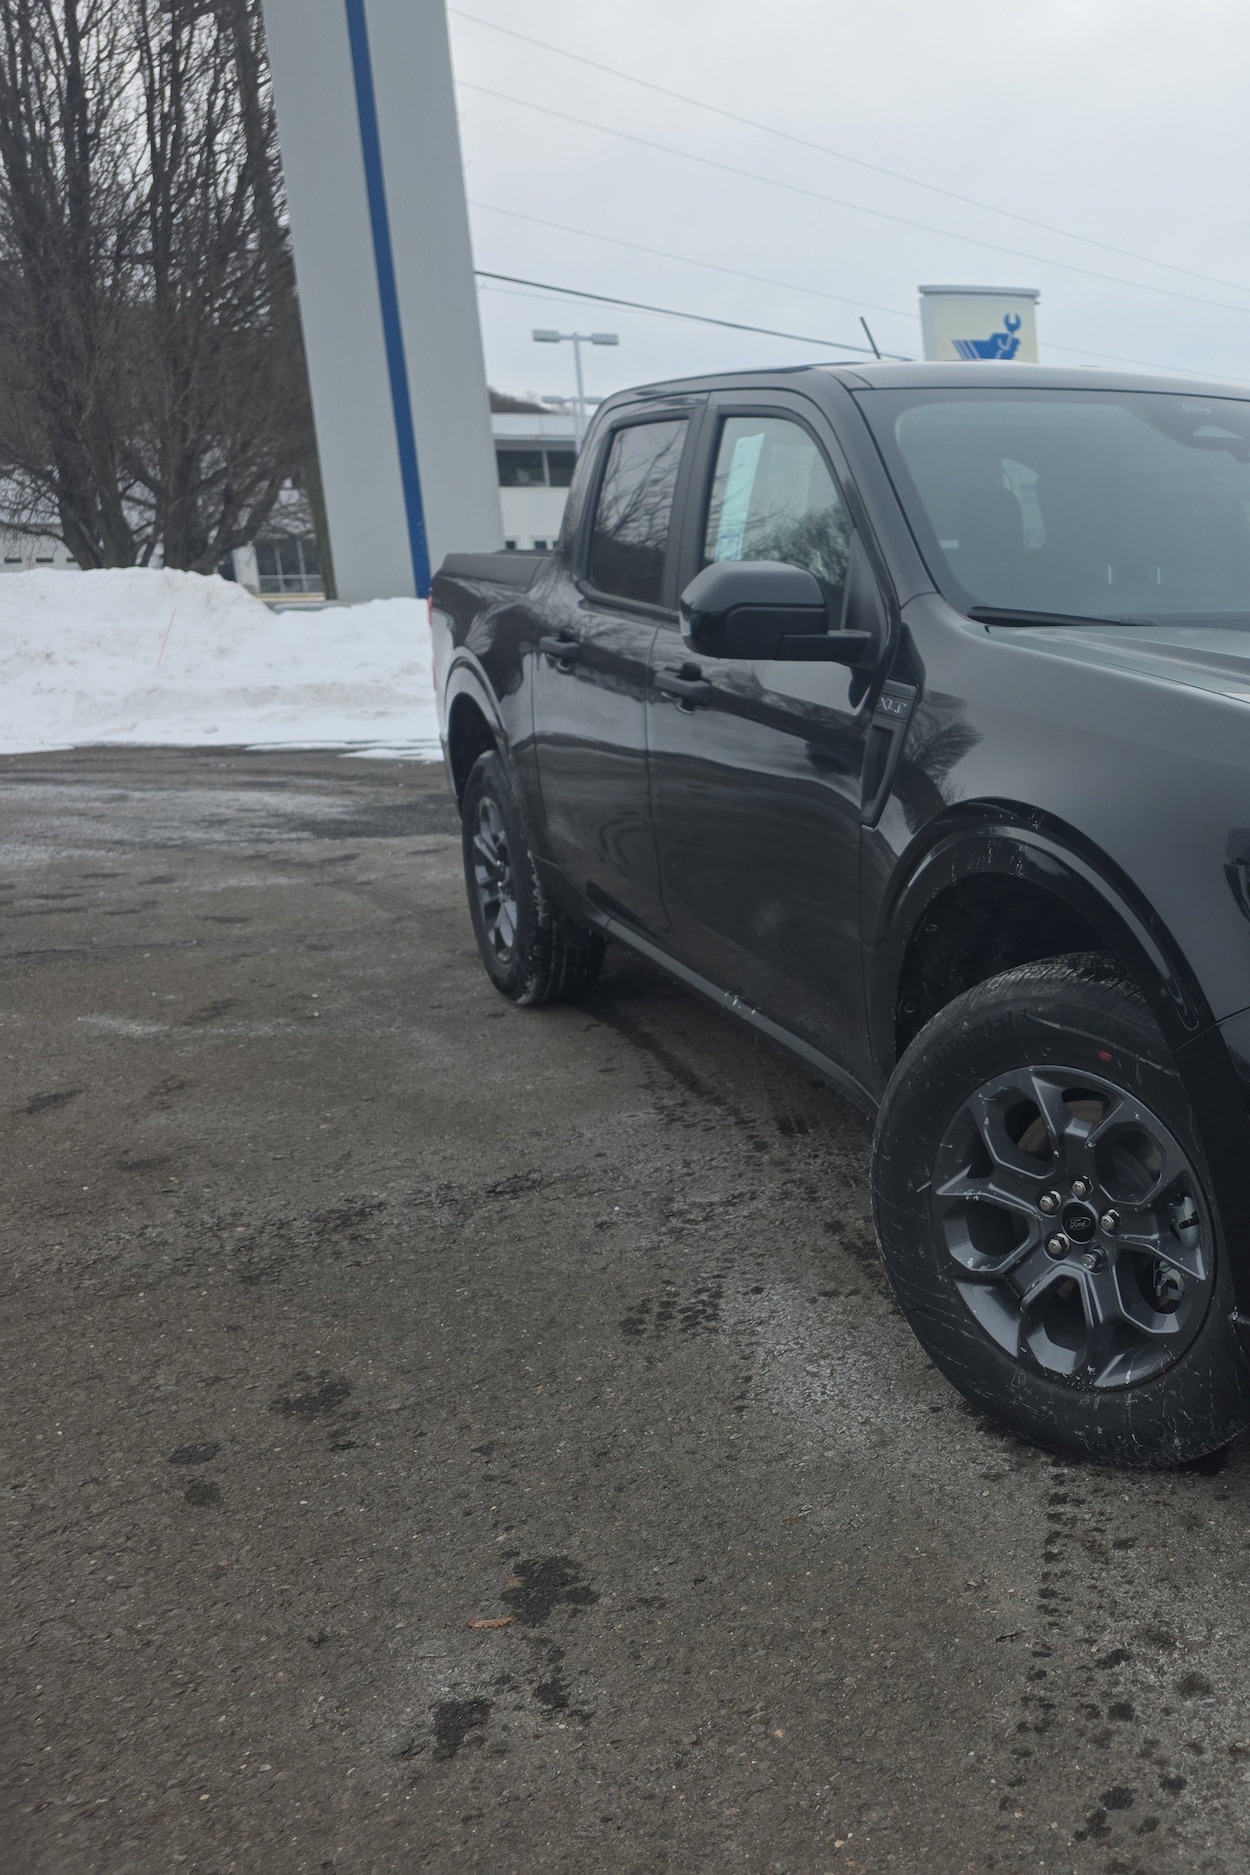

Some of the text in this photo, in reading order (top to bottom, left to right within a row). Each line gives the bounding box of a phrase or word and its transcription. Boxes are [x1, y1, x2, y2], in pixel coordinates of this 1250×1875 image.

[880, 696, 907, 714] XLT
[910, 1009, 1015, 1098] Continental
[1070, 1218, 1087, 1228] Ford
